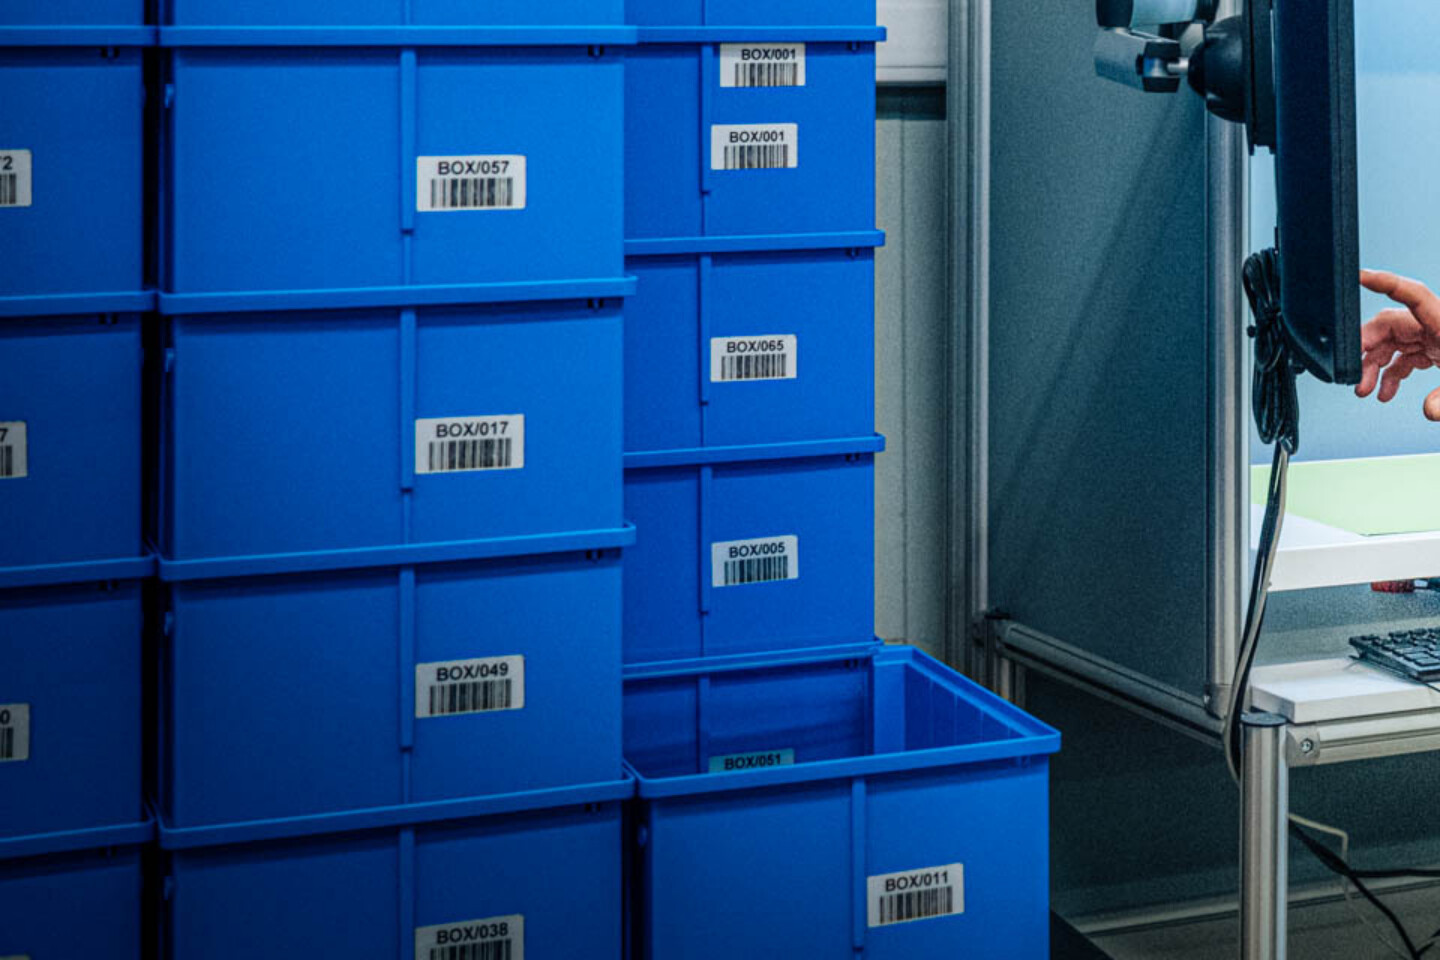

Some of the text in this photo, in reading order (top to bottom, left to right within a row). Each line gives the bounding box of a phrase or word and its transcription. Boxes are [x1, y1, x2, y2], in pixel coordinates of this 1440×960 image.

[741, 48, 798, 61] BOX/001
[729, 131, 785, 143] BOX/001
[437, 161, 510, 176] BOX/057
[726, 340, 784, 353] BOX/065
[436, 421, 509, 438] BOX/017
[729, 541, 785, 558] BOX/005
[436, 662, 509, 682] BOX/049
[724, 753, 782, 770] BOX/051
[885, 871, 949, 893] BOX/011
[436, 922, 509, 945] BOX/038
